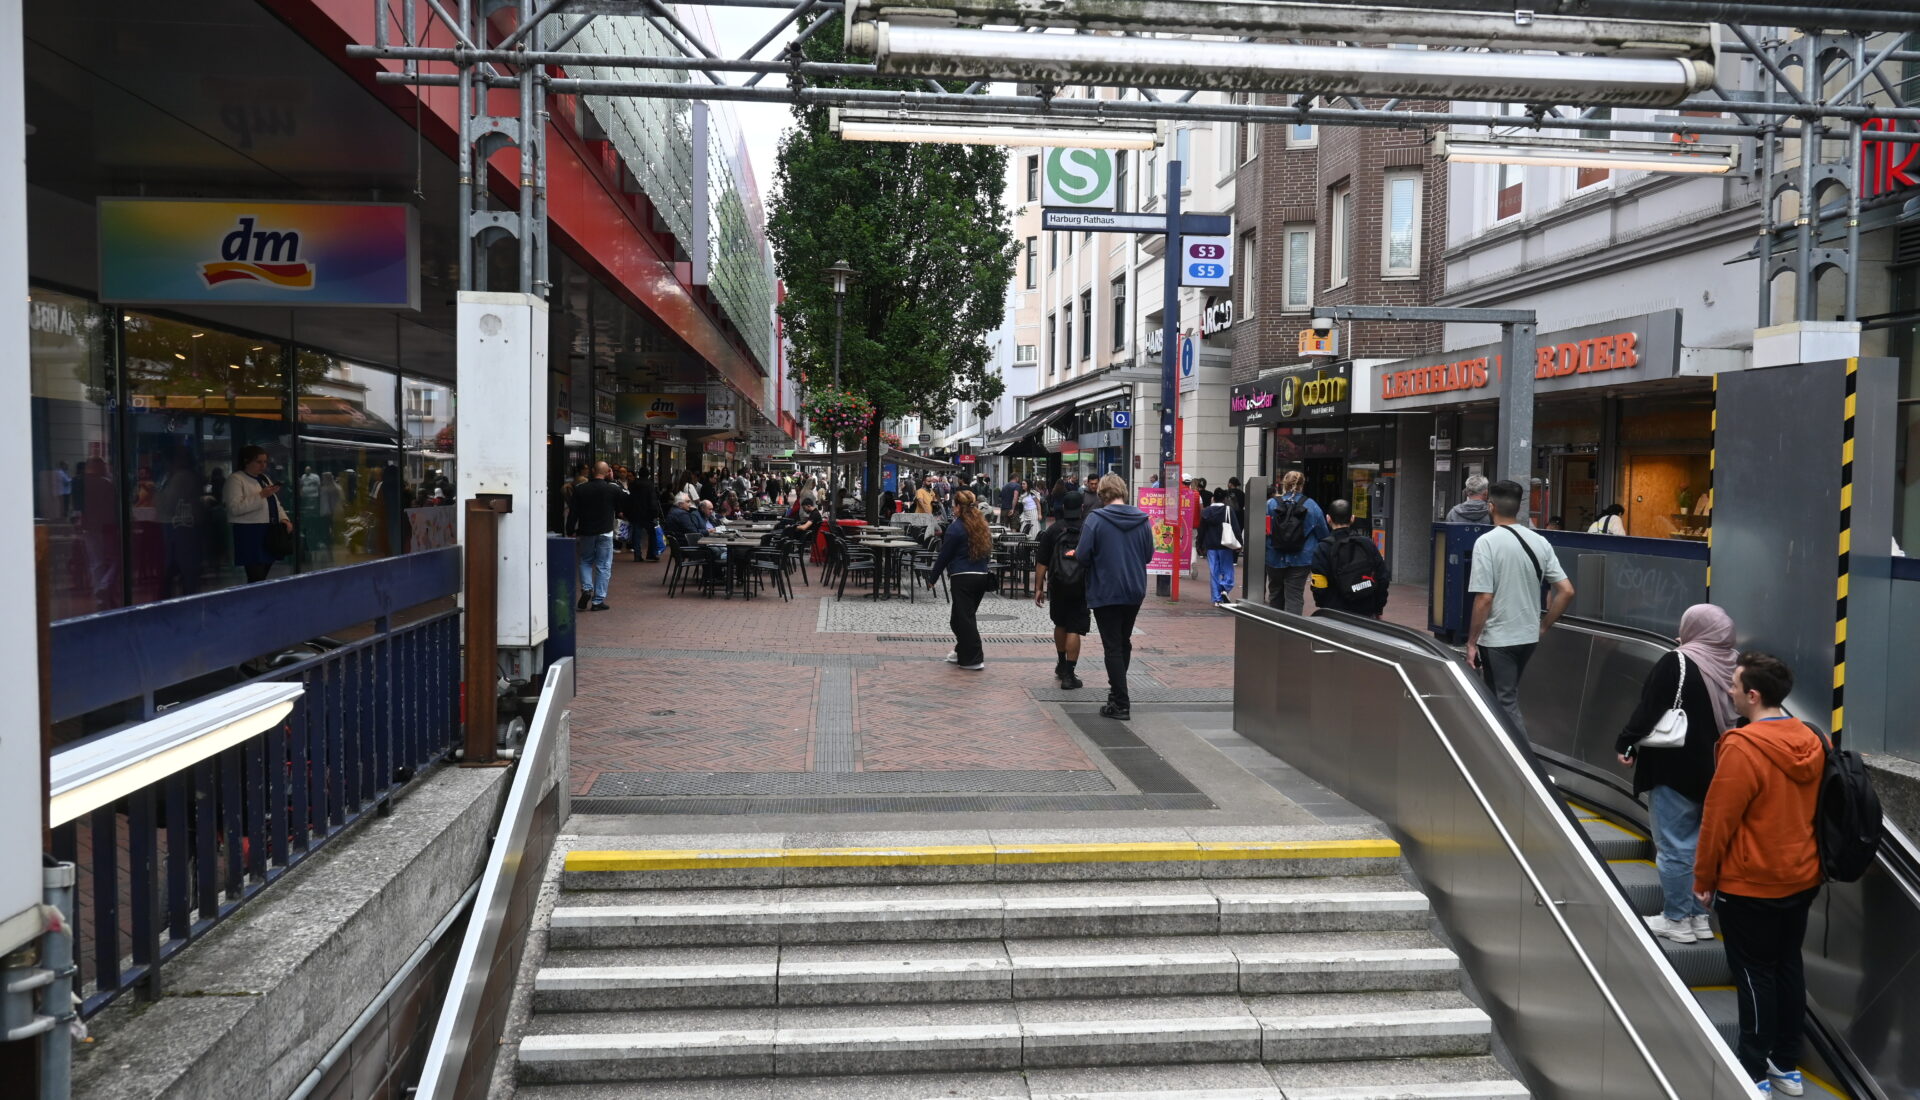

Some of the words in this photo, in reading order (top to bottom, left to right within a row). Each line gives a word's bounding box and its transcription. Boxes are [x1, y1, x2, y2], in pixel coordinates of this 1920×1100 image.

[1059, 147, 1099, 196] S
[1049, 214, 1082, 225] Harburg
[1083, 215, 1115, 225] Rathaus
[221, 217, 299, 262] dm
[1198, 245, 1216, 258] S3
[1197, 265, 1215, 277] S5
[1381, 356, 1489, 400] LEIHHAUS
[651, 398, 675, 412] dm
[1351, 579, 1373, 593] PUMA
